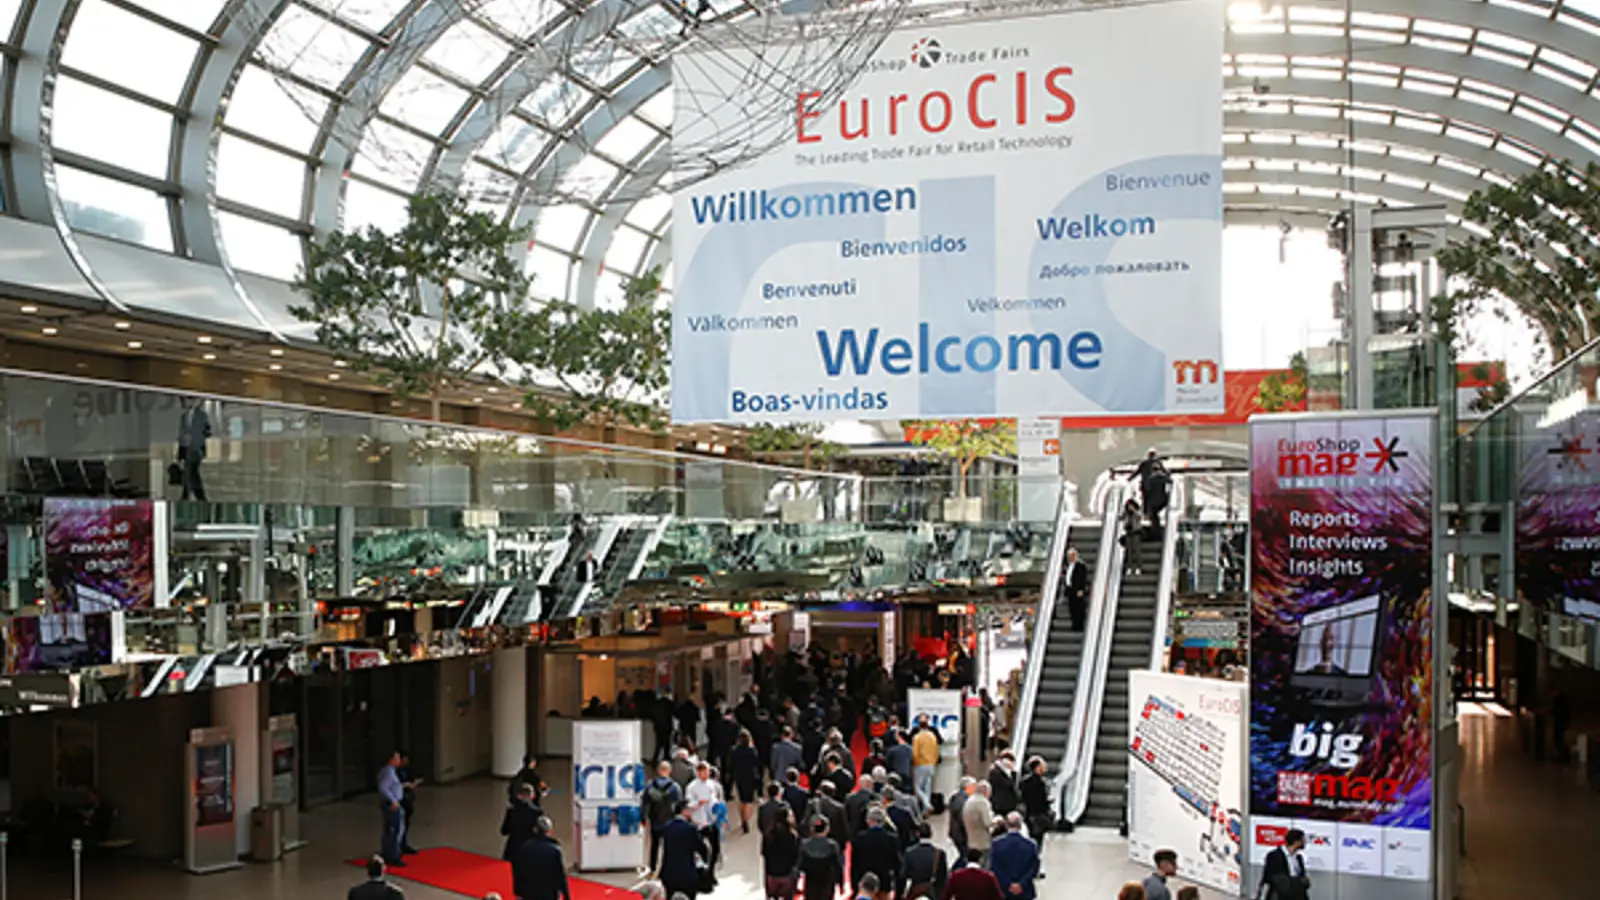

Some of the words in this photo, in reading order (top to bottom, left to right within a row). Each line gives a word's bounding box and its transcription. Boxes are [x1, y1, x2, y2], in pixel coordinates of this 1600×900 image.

[946, 50, 987, 64] Trade
[991, 46, 1031, 60] Fairs
[796, 66, 1076, 144] EuroCIS
[795, 152, 815, 166] The
[820, 149, 869, 164] Leading
[872, 146, 904, 159] Trade
[908, 144, 932, 156] Fair
[958, 139, 996, 152] Retail
[998, 134, 1073, 150] Technology
[1105, 171, 1211, 192] Bienvenue
[691, 186, 917, 225] Willkommen
[1036, 213, 1156, 240] Welkom
[840, 233, 967, 258] Bienvenidos
[1039, 263, 1091, 279] Добро
[1094, 260, 1190, 275] пожаловать
[762, 278, 857, 300] Benvenuti
[967, 294, 1066, 314] Velkommen
[687, 312, 799, 333] Välkommen
[816, 321, 1104, 377] Welcome
[731, 387, 889, 413] Boas-vindas
[1279, 438, 1360, 452] EuroShop
[1279, 452, 1359, 475] mag
[1289, 509, 1361, 529] Reports
[1289, 531, 1388, 551] Interviews
[1289, 557, 1364, 579] Insights
[1290, 722, 1363, 767] big
[1314, 774, 1400, 802] mag
